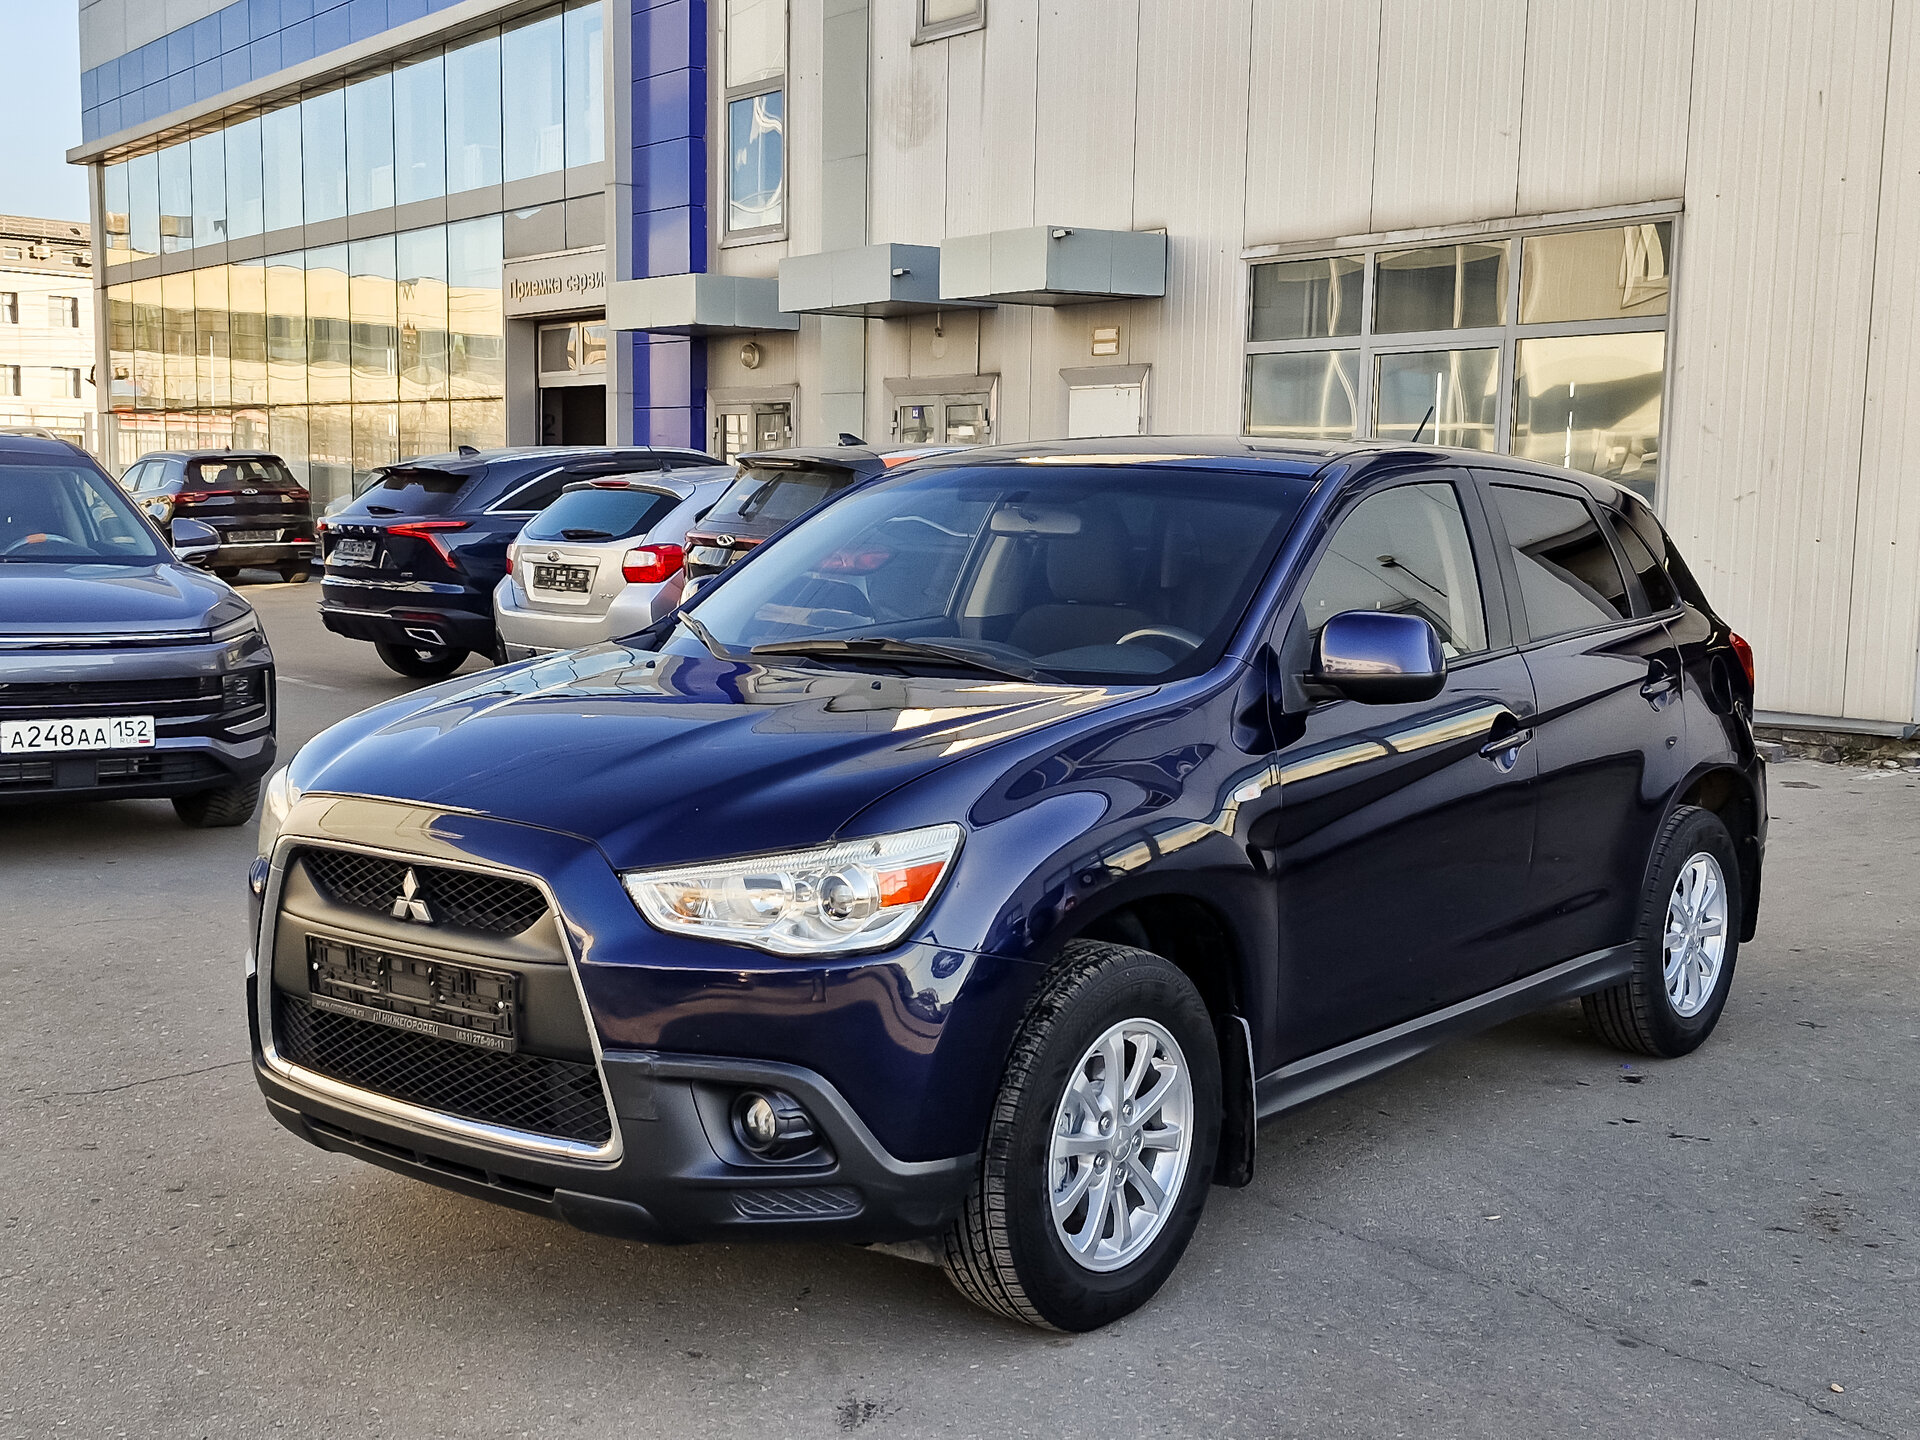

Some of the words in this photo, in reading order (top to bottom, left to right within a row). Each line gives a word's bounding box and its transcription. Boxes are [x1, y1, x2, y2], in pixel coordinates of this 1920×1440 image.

[510, 277, 563, 303] Приемка
[566, 271, 606, 295] серви
[113, 720, 148, 738] 152
[381, 1013, 439, 1036] НИЖЕГОРОДЕЦ
